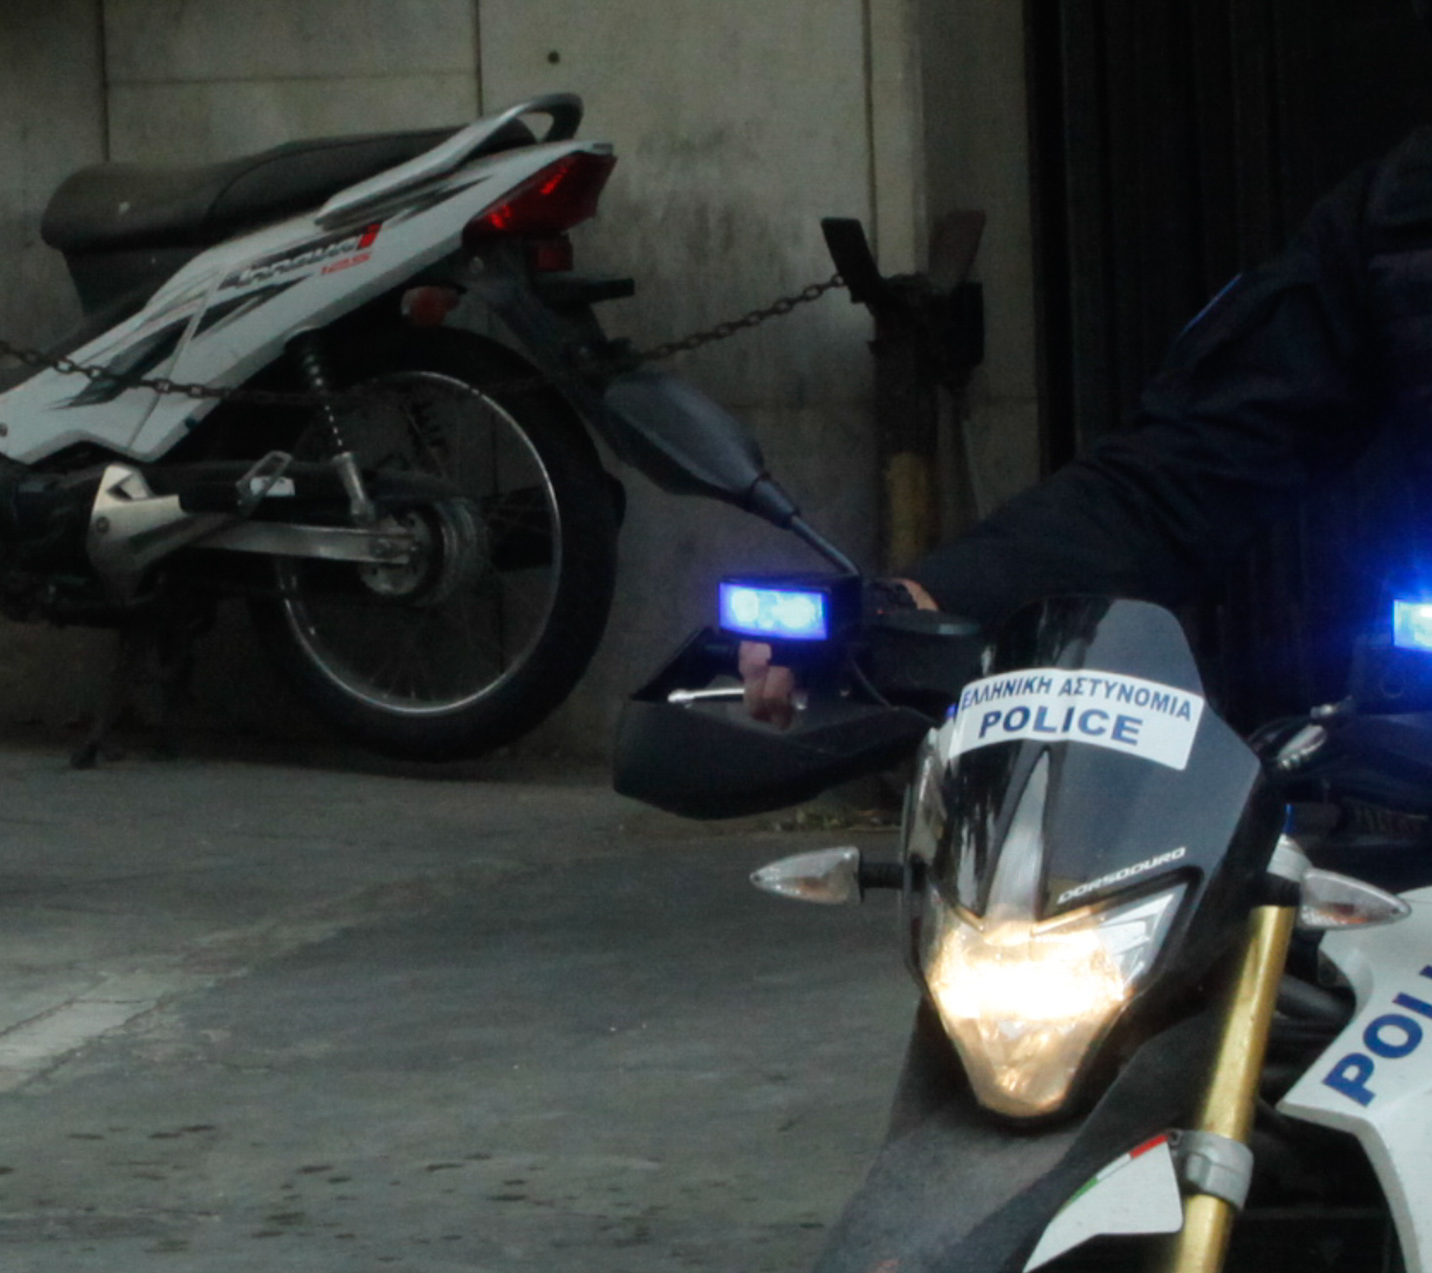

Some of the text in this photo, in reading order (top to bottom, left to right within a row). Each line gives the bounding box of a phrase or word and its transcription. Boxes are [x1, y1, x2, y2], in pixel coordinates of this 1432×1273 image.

[961, 675, 1193, 722] ΕΛΛΗΝΙΚΗ ΑΣΤΥΝΟΜΙΑ
[977, 704, 1144, 747] POLICE
[1057, 846, 1187, 905] DORSODURO
